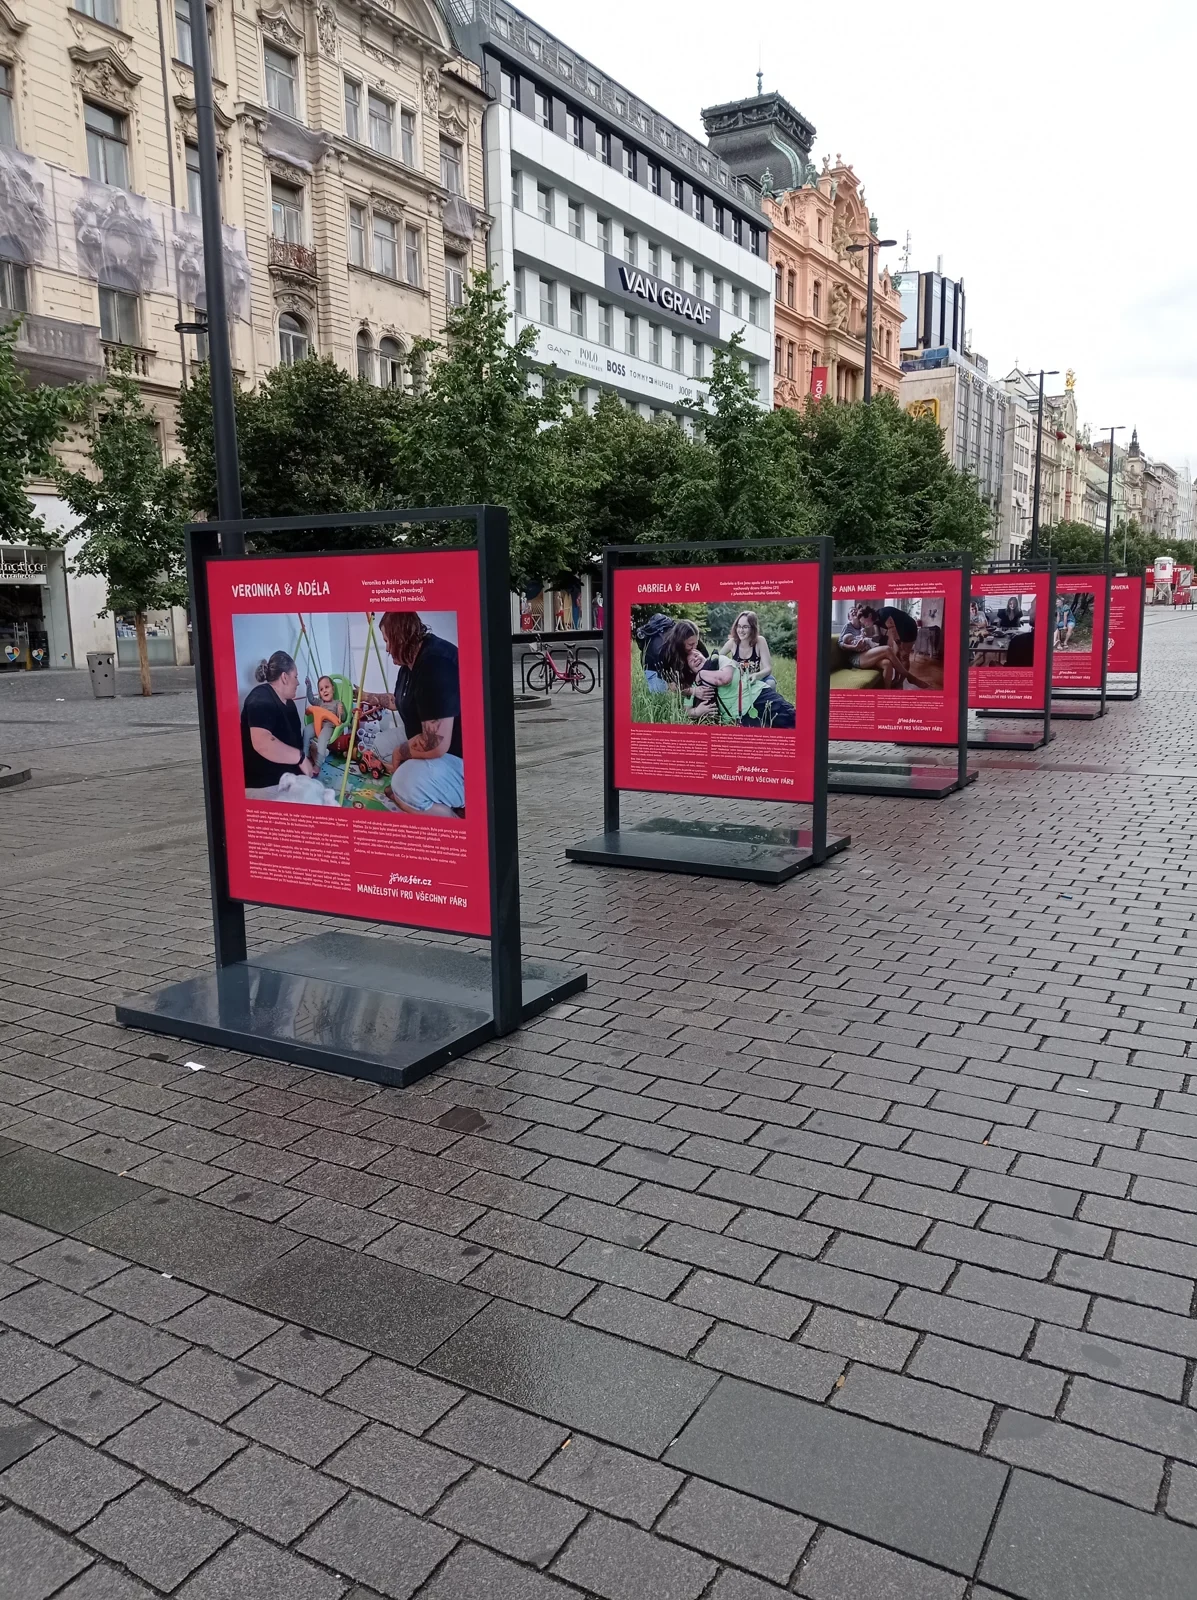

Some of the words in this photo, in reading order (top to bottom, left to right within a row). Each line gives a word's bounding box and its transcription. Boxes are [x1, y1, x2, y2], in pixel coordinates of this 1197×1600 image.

[621, 266, 658, 302] VAN
[661, 286, 712, 324] GRAAF
[547, 344, 572, 356] GANT
[580, 348, 598, 362] POLO
[606, 360, 626, 376] BOSS
[630, 370, 648, 384] TOMMY
[654, 380, 674, 390] HILFIGER
[232, 582, 281, 598] VERONIKA
[284, 583, 292, 596] &
[297, 579, 330, 596] ADÉLA
[675, 583, 682, 592] &
[685, 582, 700, 592] EVA
[712, 774, 743, 782] MANŽELSTVÍ
[756, 776, 779, 784] VŠECHNY
[781, 777, 794, 785] PÁRY
[357, 884, 399, 898] MANŽELSTVÍ
[400, 889, 413, 900] PRO
[416, 890, 448, 904] VŠECHNY
[450, 896, 467, 908] PÁRY
